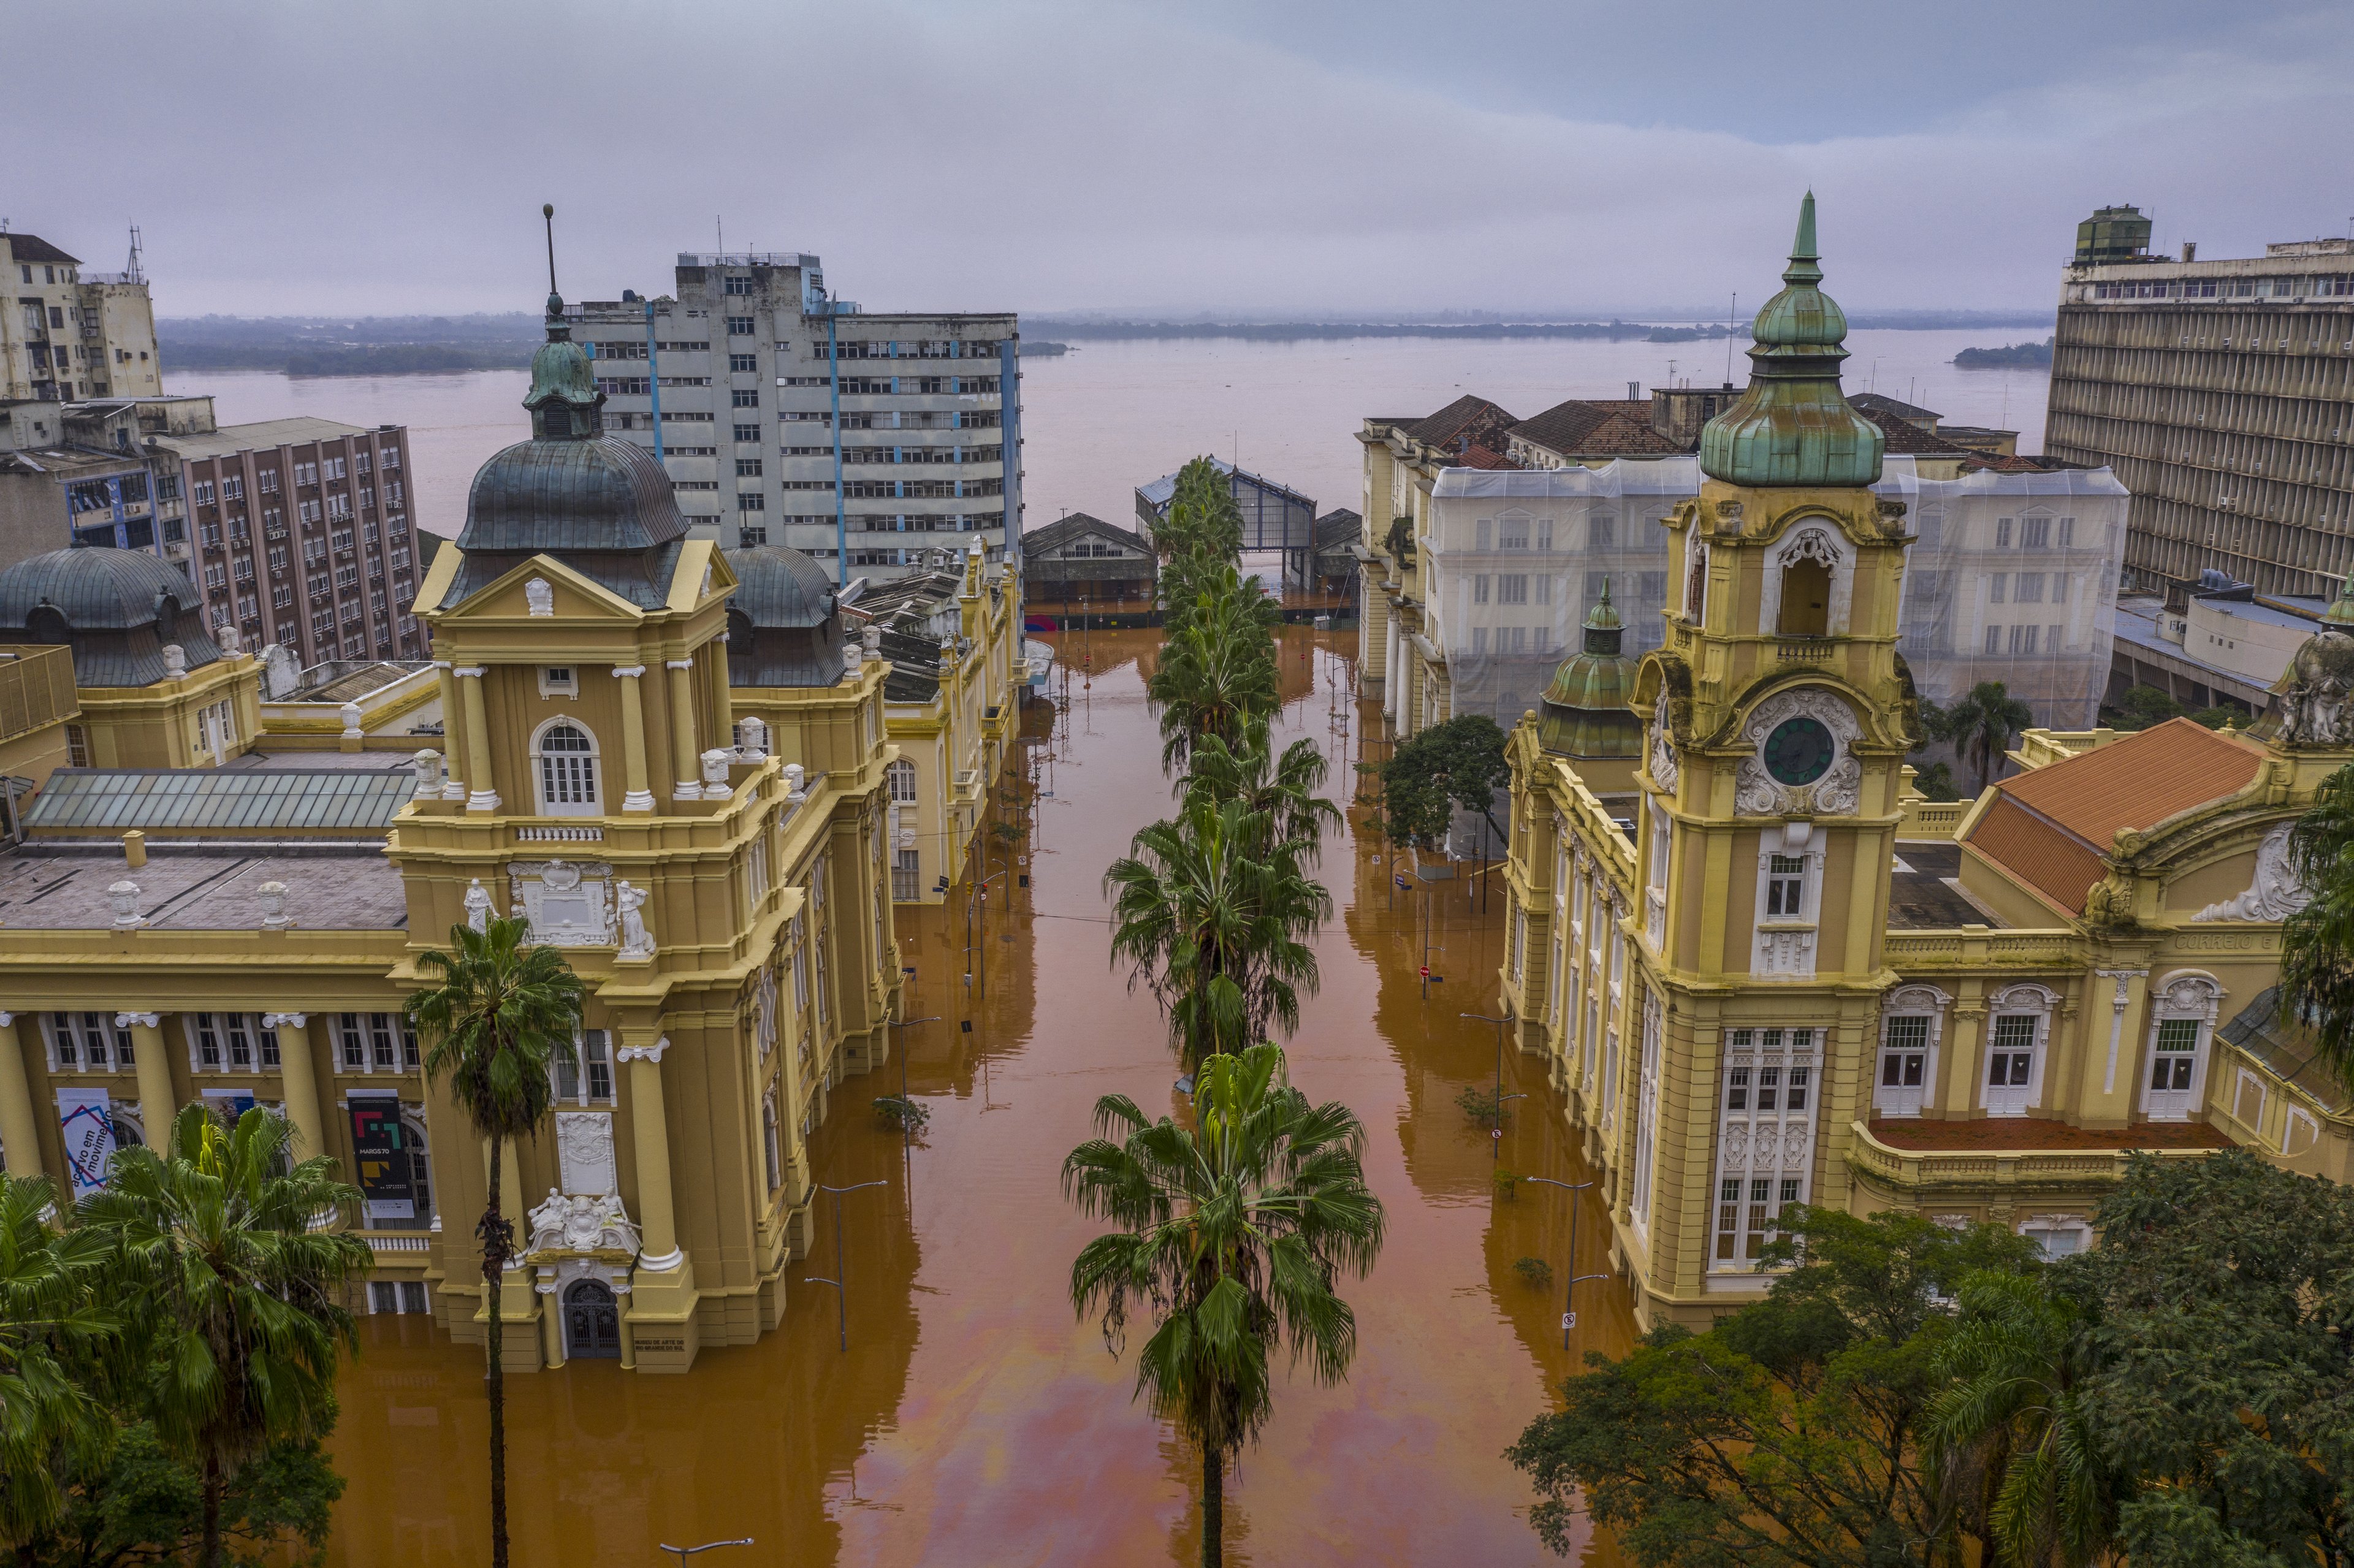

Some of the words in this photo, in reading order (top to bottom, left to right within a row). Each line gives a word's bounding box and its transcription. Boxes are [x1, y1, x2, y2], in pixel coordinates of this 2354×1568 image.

[2176, 934, 2252, 950] CORREIO
[2261, 936, 2272, 949] E
[72, 1149, 89, 1187] acervo
[83, 1130, 96, 1147] em
[87, 1110, 112, 1173] movimento
